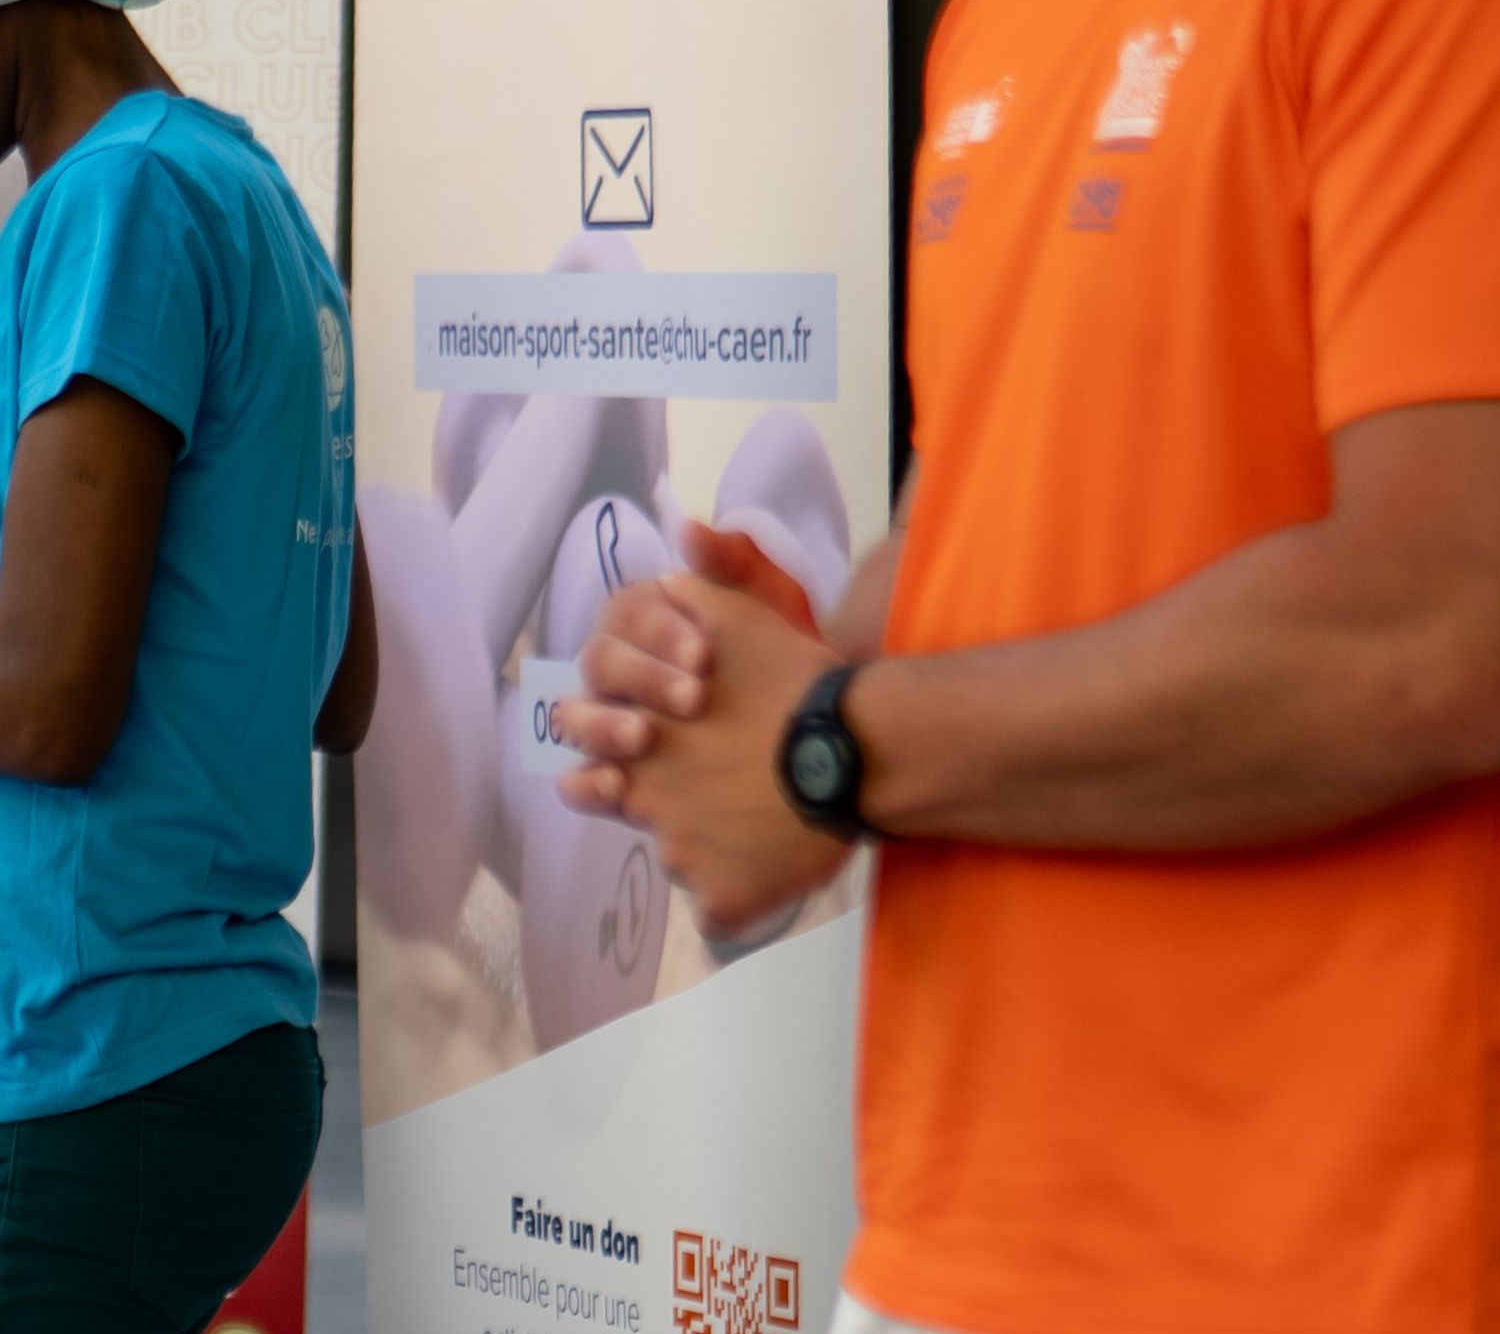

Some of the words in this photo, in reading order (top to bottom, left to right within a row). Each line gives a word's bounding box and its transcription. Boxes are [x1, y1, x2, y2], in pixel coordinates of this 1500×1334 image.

[438, 310, 812, 372] maison-sport-sante@chu-caen.fr
[511, 1194, 564, 1247] Faire
[569, 1212, 595, 1253] un
[601, 1216, 640, 1267] don
[453, 1248, 550, 1310] Ensemble
[555, 1278, 598, 1326] pour
[604, 1292, 640, 1334] une
